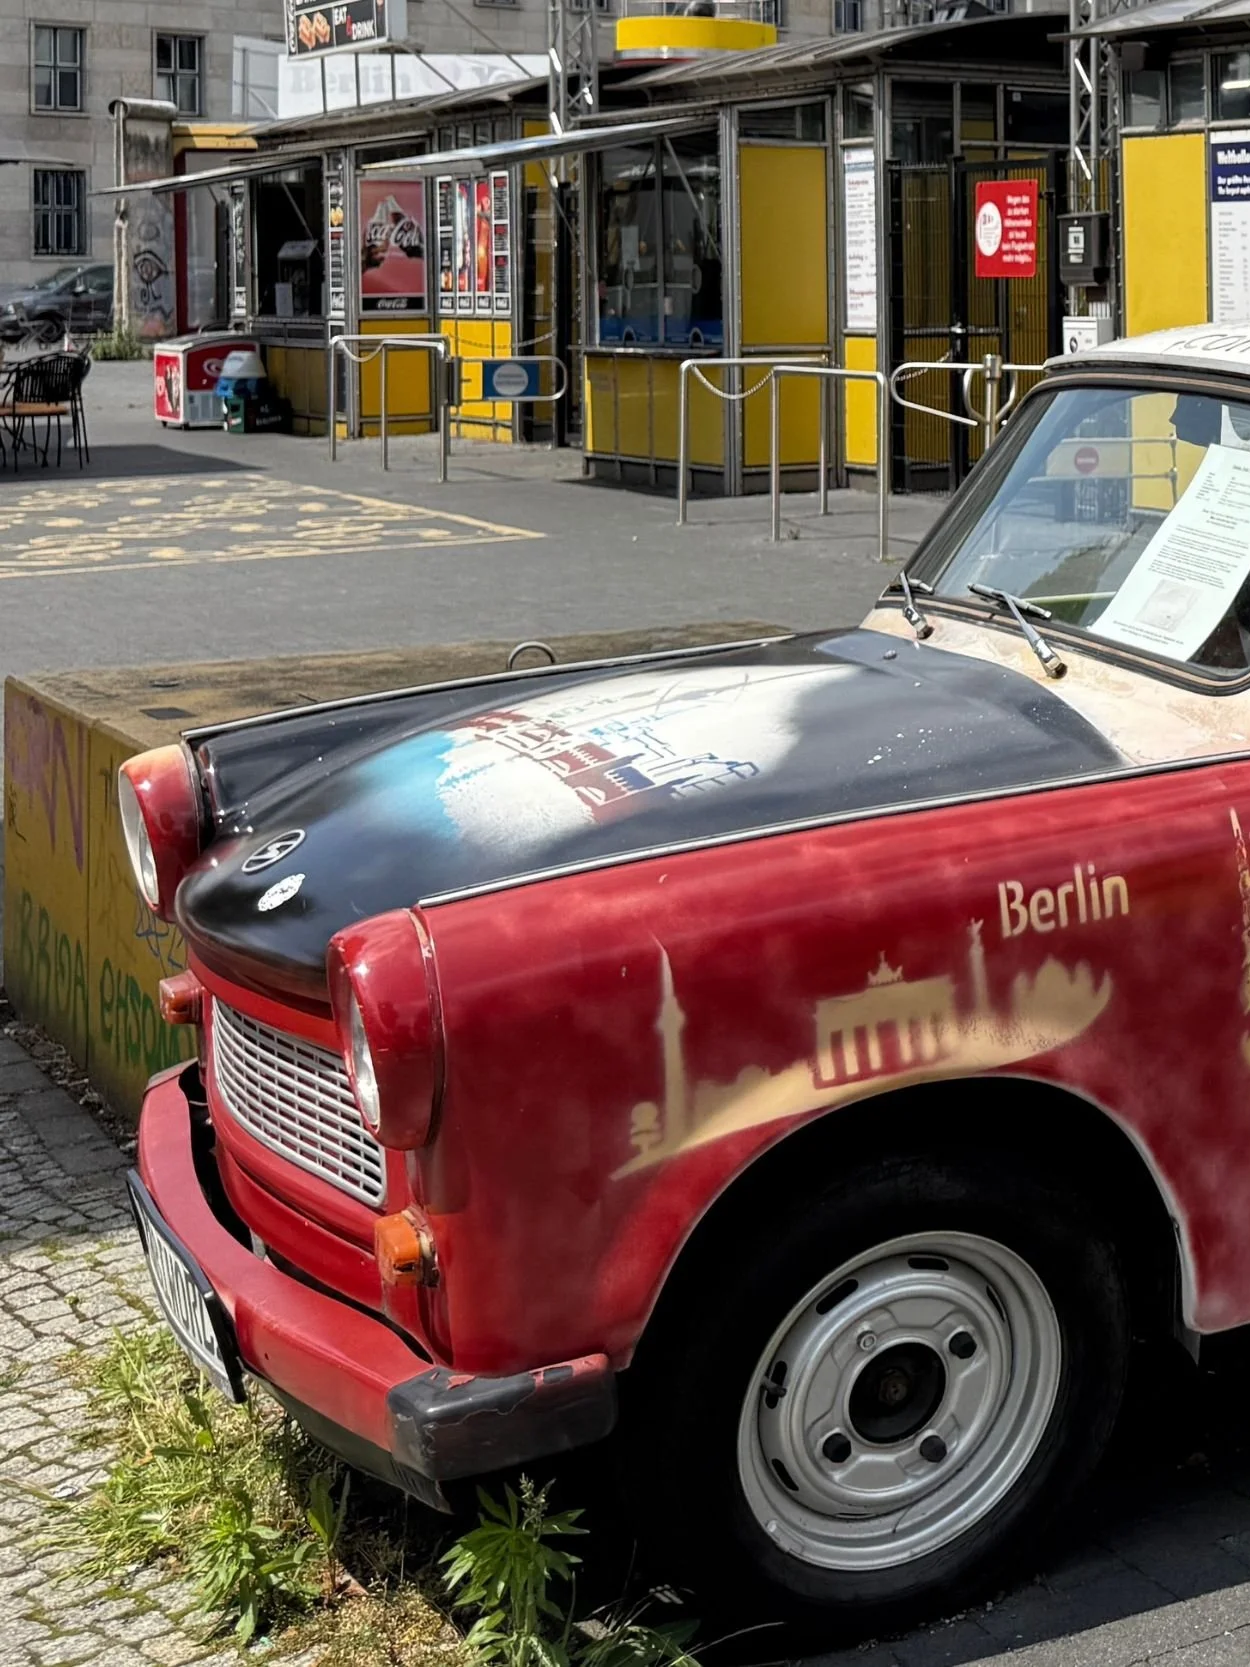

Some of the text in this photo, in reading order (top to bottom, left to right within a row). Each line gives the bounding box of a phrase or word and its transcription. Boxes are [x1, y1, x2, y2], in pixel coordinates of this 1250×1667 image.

[335, 6, 347, 26] EAT
[352, 19, 375, 40] DRINK
[998, 861, 1129, 939] Berlin
